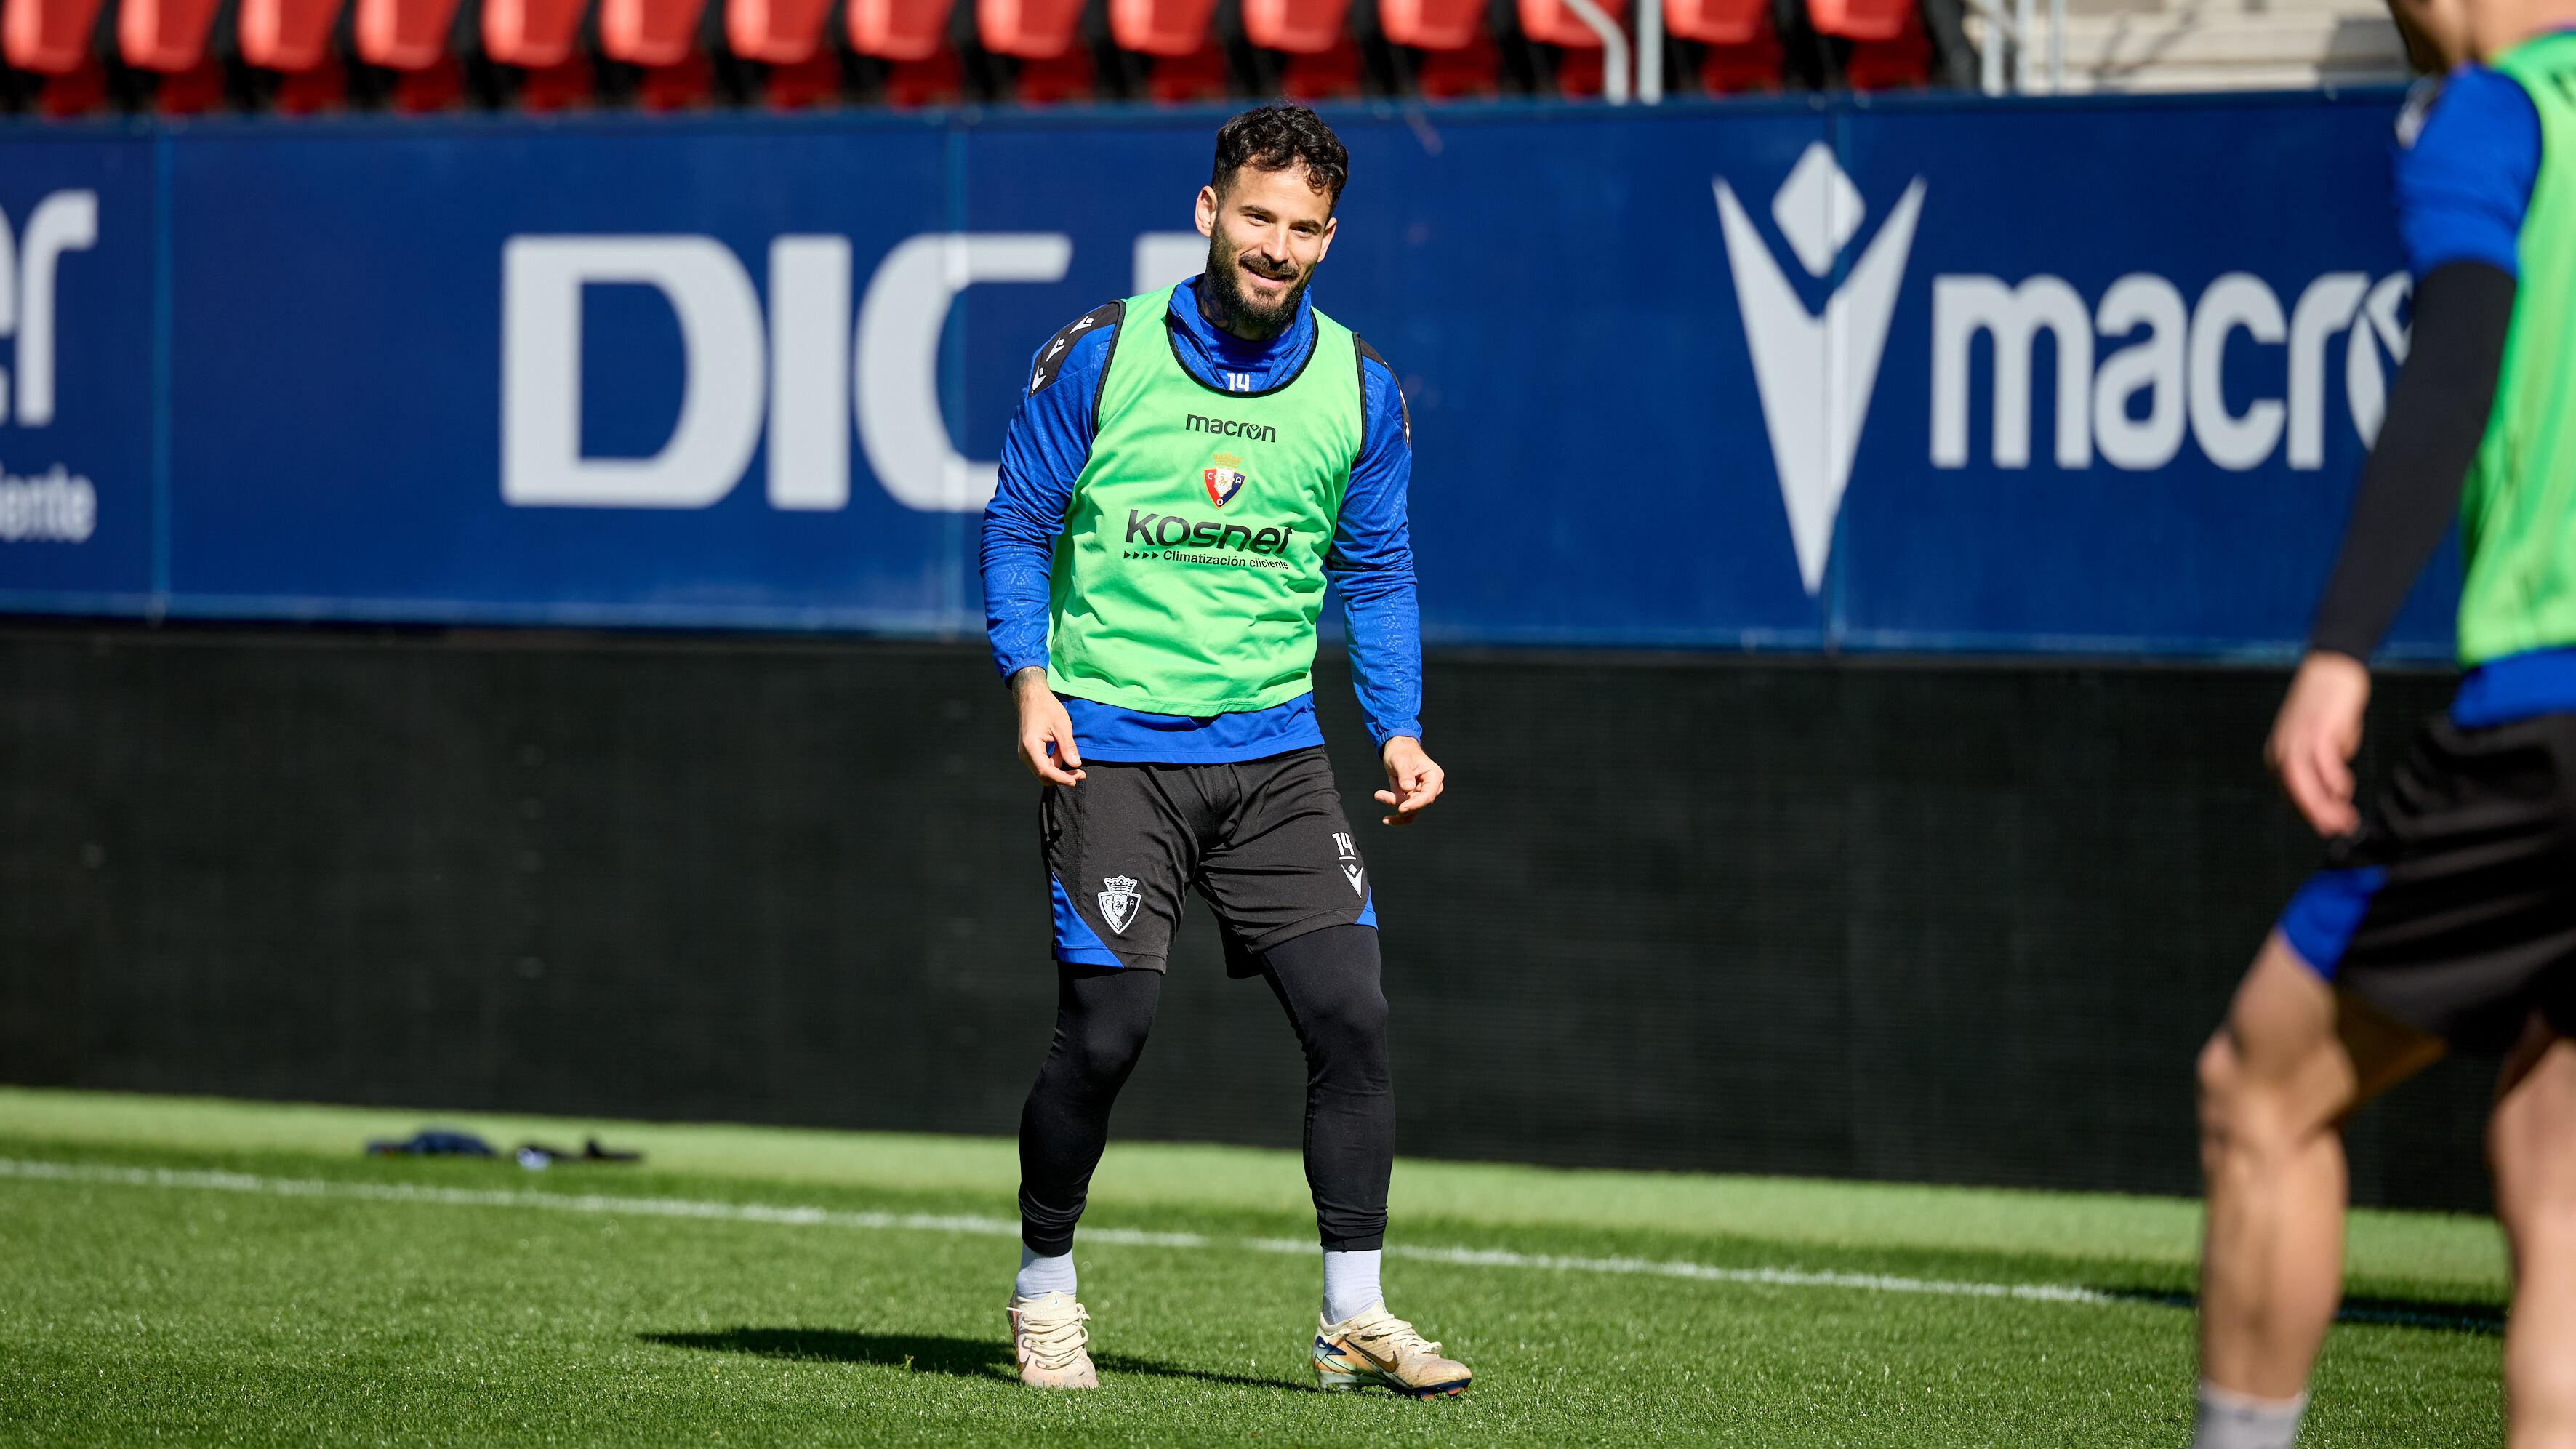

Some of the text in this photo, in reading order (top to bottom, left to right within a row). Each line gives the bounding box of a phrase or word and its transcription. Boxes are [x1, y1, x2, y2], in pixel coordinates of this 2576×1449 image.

[1227, 373, 1250, 391] 14
[1186, 414, 1276, 443] macron
[1163, 550, 1245, 567] Climatización
[1332, 832, 1355, 855] 14
